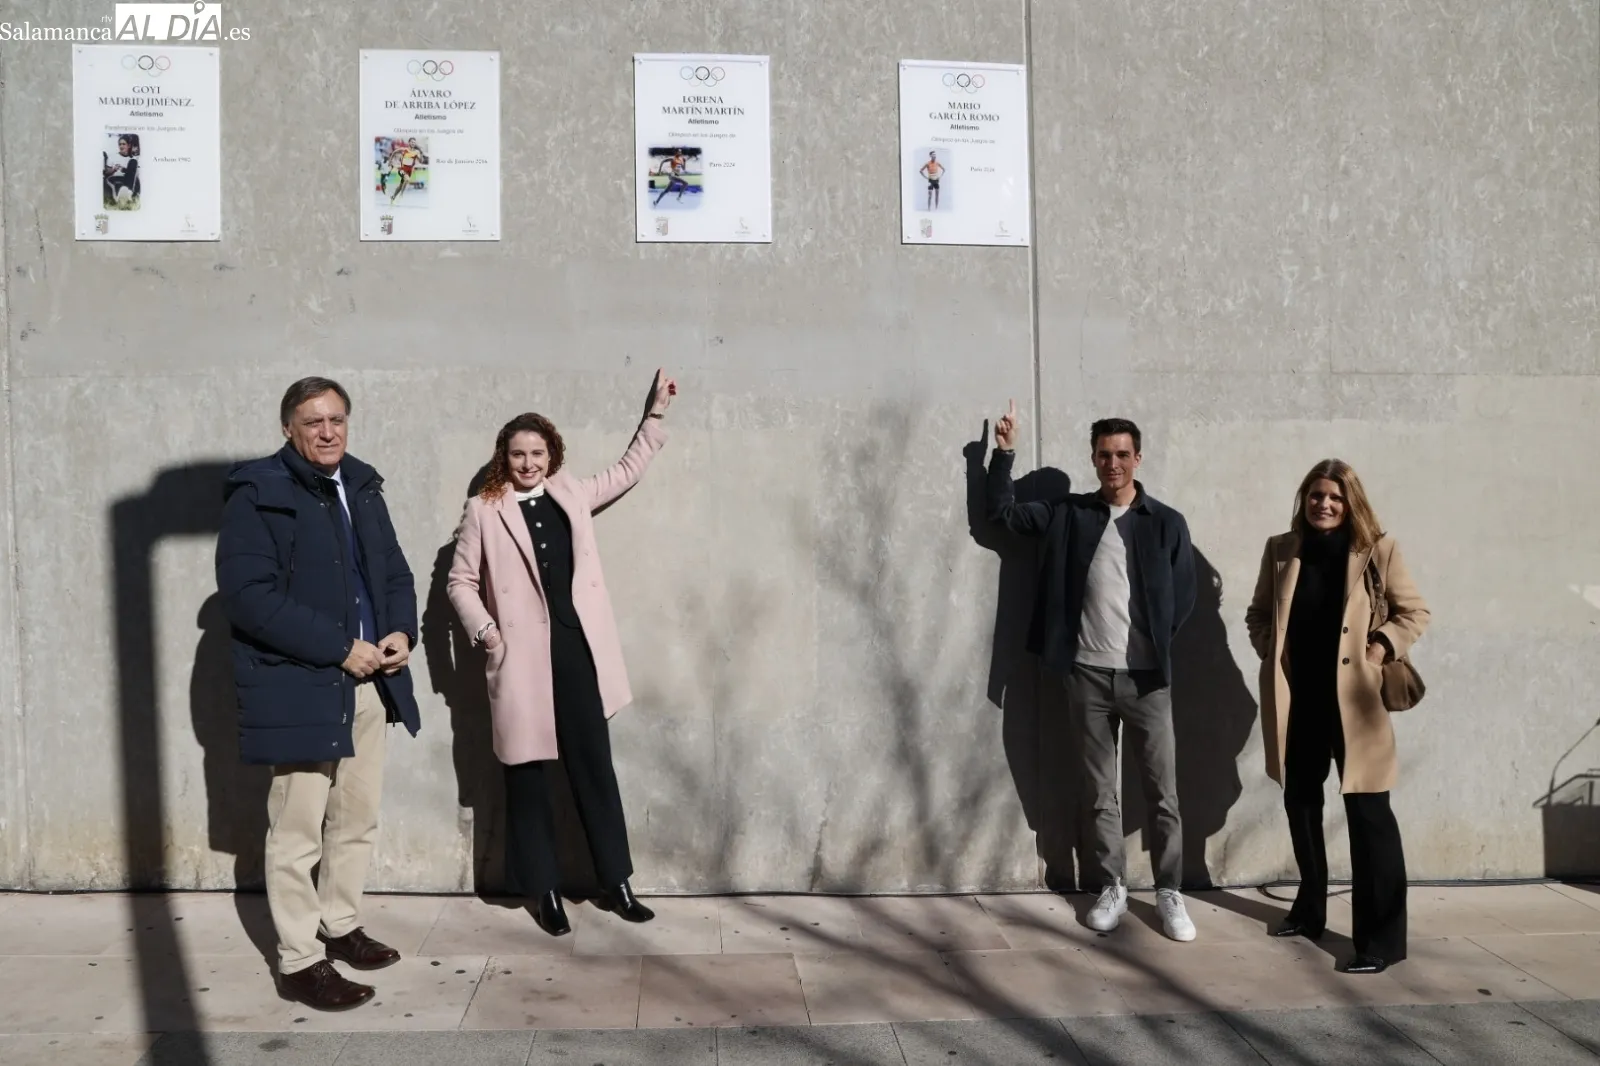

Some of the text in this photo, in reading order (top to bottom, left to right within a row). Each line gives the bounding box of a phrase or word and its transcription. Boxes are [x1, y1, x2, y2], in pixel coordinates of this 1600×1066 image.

[132, 85, 161, 94] GOYI
[410, 88, 452, 98] ÁLVARO
[98, 97, 144, 106] MADRID
[682, 95, 724, 104] LORENA
[385, 99, 476, 110] DE ARRIBA LÓPEZ
[948, 101, 981, 110] MARIO
[129, 110, 164, 118] Atletismo
[662, 105, 745, 115] MARTÍN MARTÍN
[414, 113, 447, 121] Atletismo
[929, 111, 1000, 122] GARCÍA ROMO
